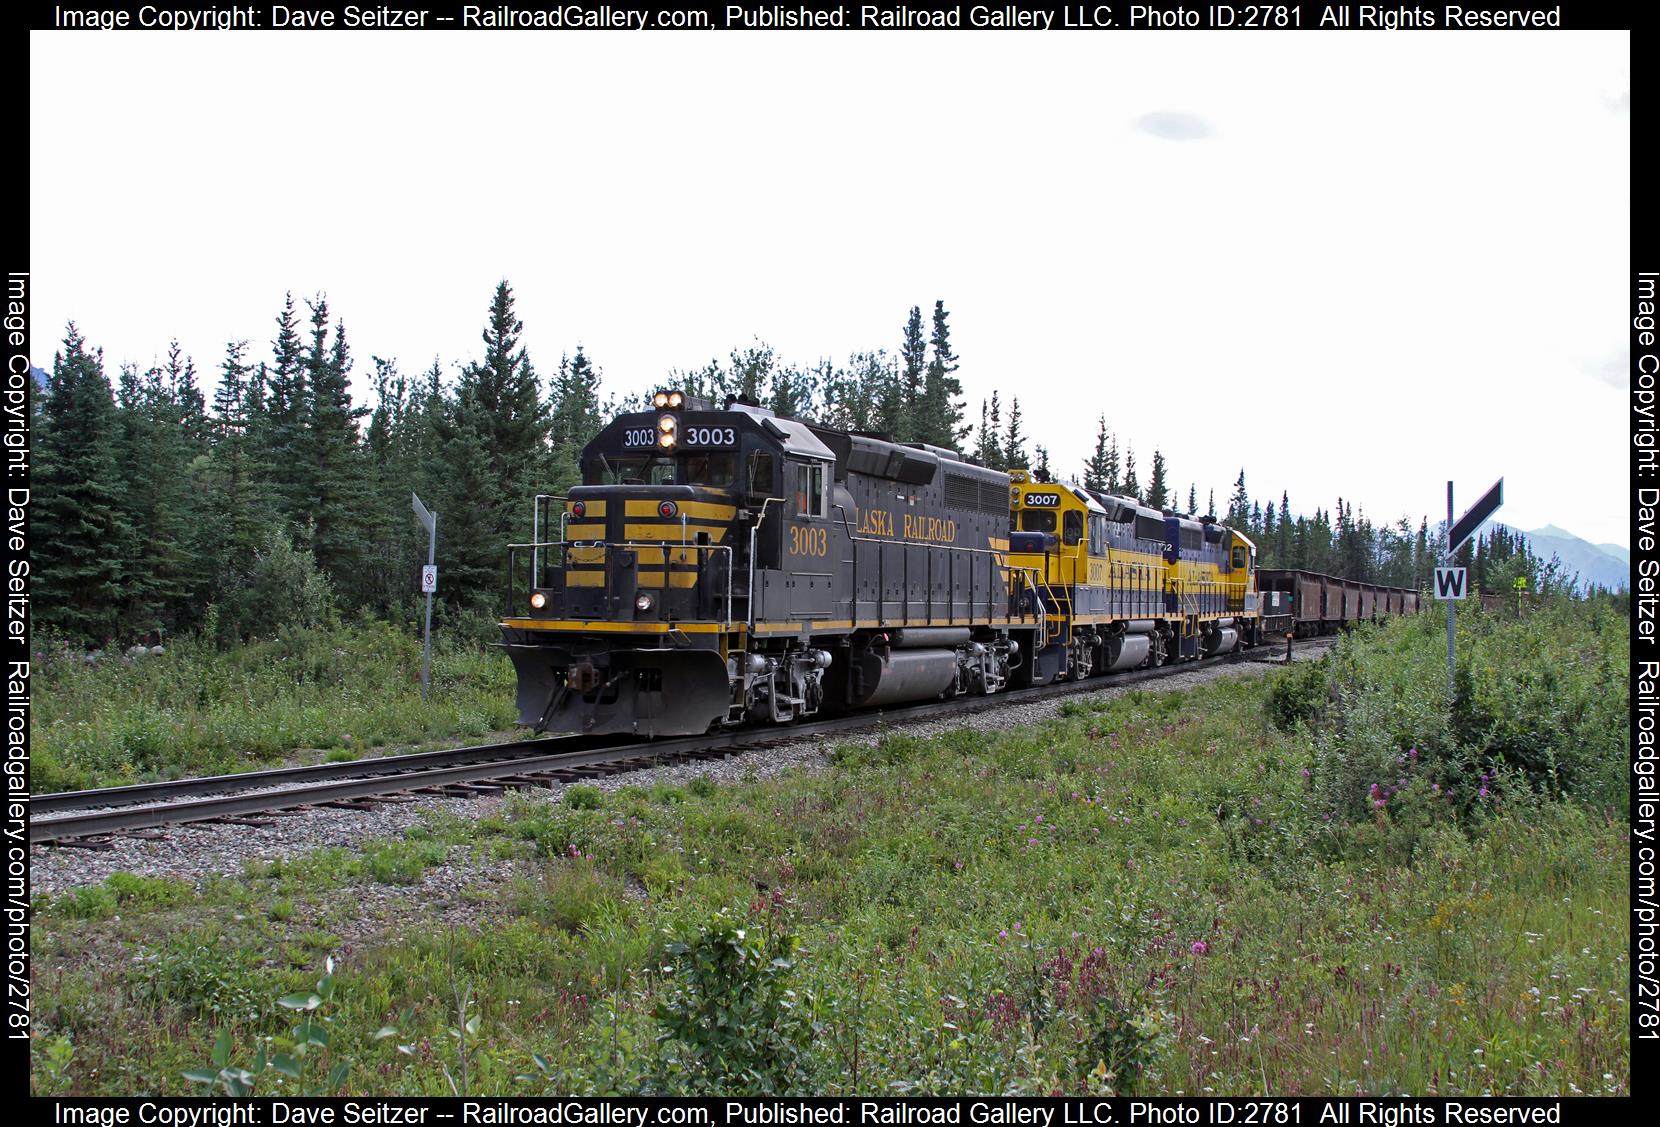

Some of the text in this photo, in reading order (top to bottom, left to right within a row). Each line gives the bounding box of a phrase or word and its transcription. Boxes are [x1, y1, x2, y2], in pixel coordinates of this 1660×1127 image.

[625, 429, 655, 446] 3003
[687, 428, 735, 445] 3003
[1027, 495, 1058, 505] 3007
[855, 507, 955, 543] LASKA RAILROAD
[789, 526, 827, 557] 3003
[1436, 570, 1464, 597] W
